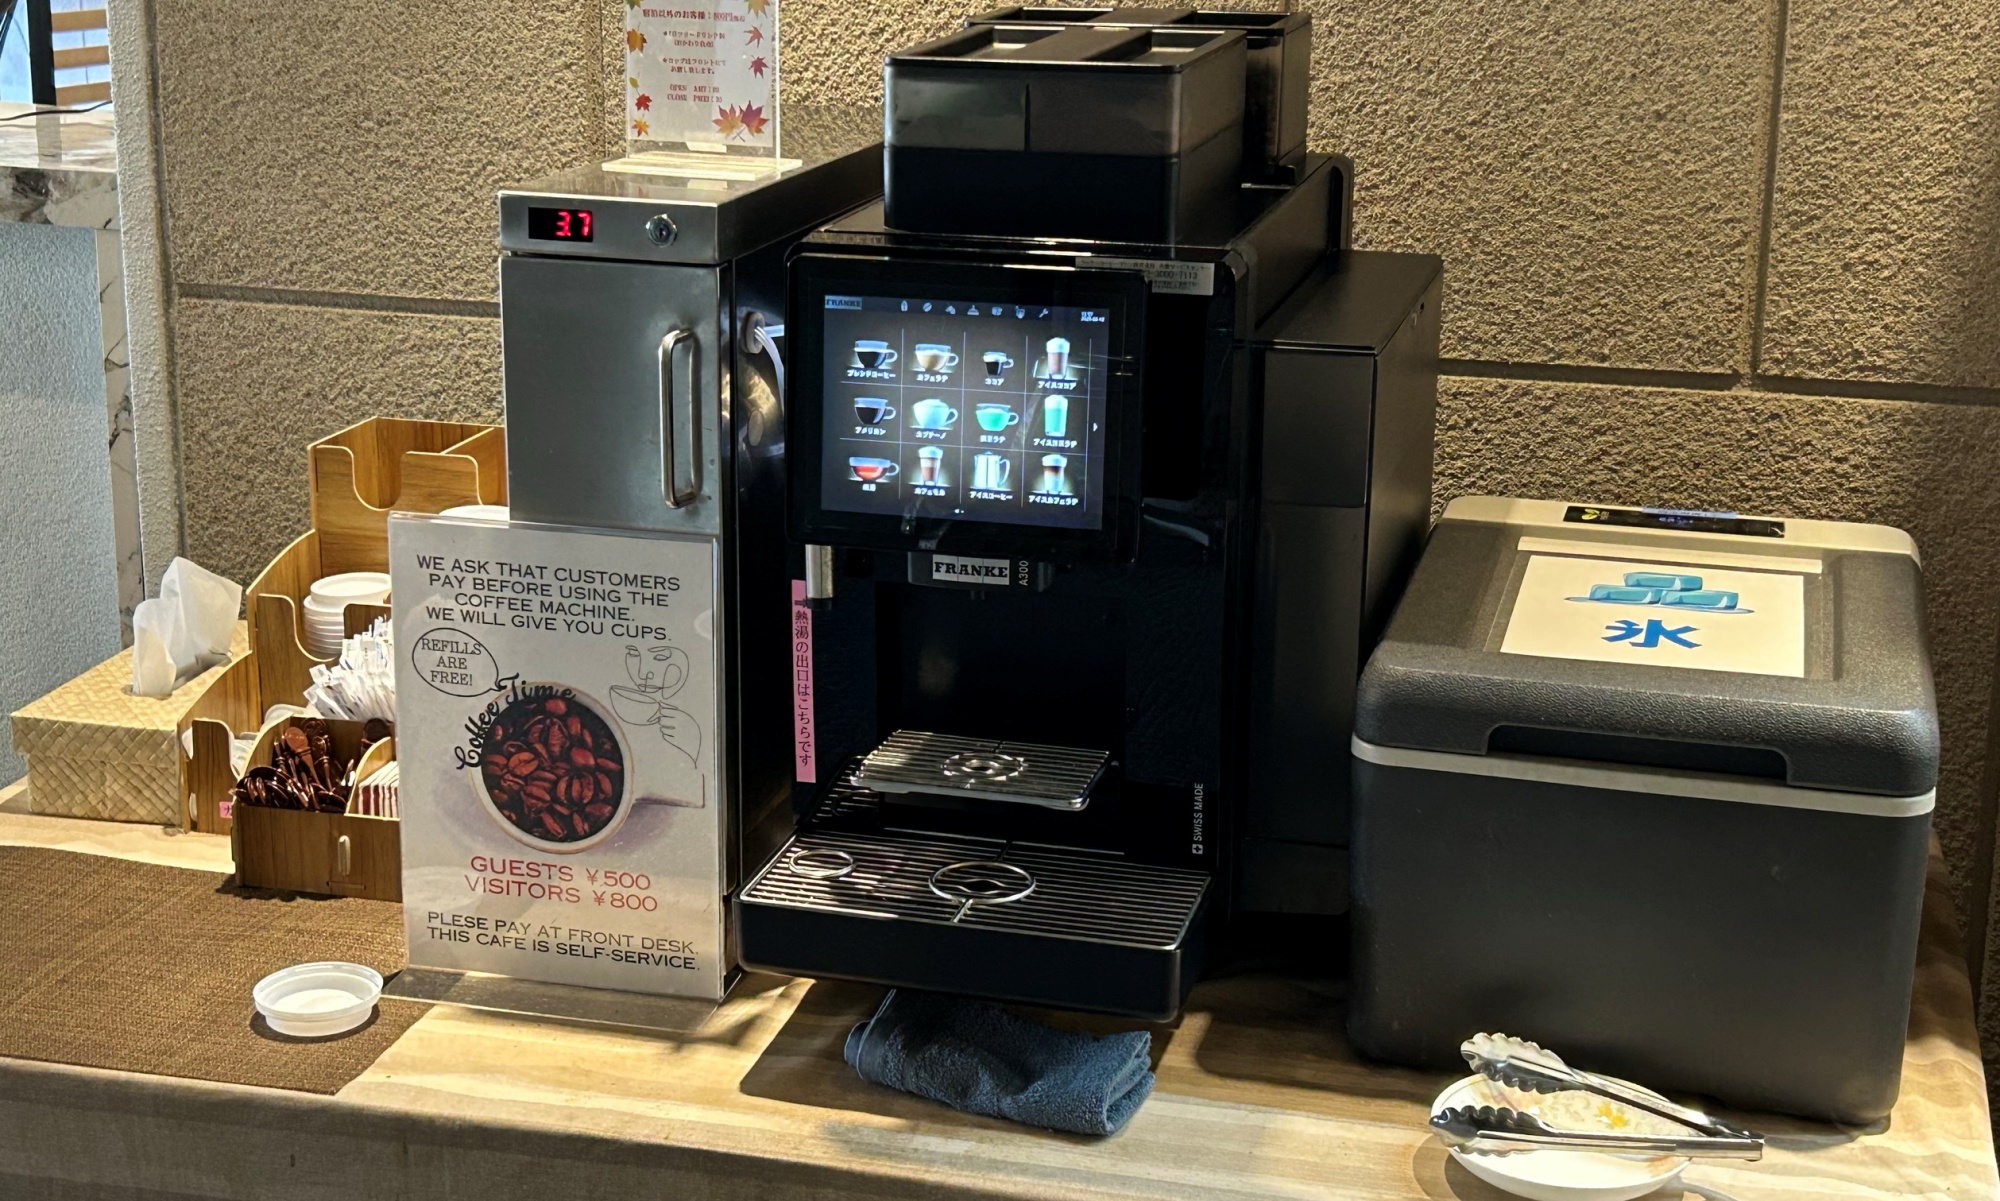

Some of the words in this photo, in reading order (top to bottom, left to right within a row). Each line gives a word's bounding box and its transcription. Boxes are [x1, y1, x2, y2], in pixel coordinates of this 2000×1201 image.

[826, 298, 861, 308] FRANKE
[984, 378, 1005, 386] ココア
[1038, 381, 1077, 390] アイスココア
[855, 426, 887, 436] アメリカン
[969, 491, 1014, 501] アイスコーヒー
[417, 554, 445, 571] WE
[451, 558, 490, 575] ASK
[496, 562, 548, 580] THAT
[554, 567, 680, 591] CUSTOMERS
[934, 561, 1008, 578] FRANKE
[1018, 560, 1029, 586] A300
[429, 573, 465, 590] PAY
[473, 578, 552, 597] BEFORE
[559, 585, 622, 603] USING
[627, 591, 669, 607] THE
[455, 593, 533, 612] COFFEE
[540, 601, 635, 622] MACHINE.
[426, 606, 454, 621] WE
[461, 609, 505, 626] WILL
[511, 614, 557, 631] GIVE
[563, 618, 604, 636] YOU
[611, 623, 672, 642] CUPS.
[1601, 619, 1702, 649] 氷
[421, 638, 482, 656] REFILLS
[430, 670, 473, 686] FREE!
[436, 657, 467, 670] ARE
[794, 610, 812, 767] 熱湯の出口はこちらです
[454, 699, 500, 770] Coffee
[498, 672, 576, 704] Time
[1193, 782, 1204, 810] MADE
[1193, 812, 1203, 841] SWISS
[470, 855, 574, 882] GUESTS
[586, 868, 651, 890] ¥500
[465, 875, 581, 903] VISITORS
[593, 890, 658, 912] ¥800
[428, 911, 488, 931] PLESE
[495, 919, 531, 936] PAY
[537, 925, 562, 939] AT
[568, 928, 634, 948] FRONT
[641, 937, 699, 955] DESK.
[427, 926, 470, 943] THIS
[476, 932, 526, 950] CAFE
[532, 940, 550, 953] IS
[556, 942, 700, 971] SELF-SERVICE.
